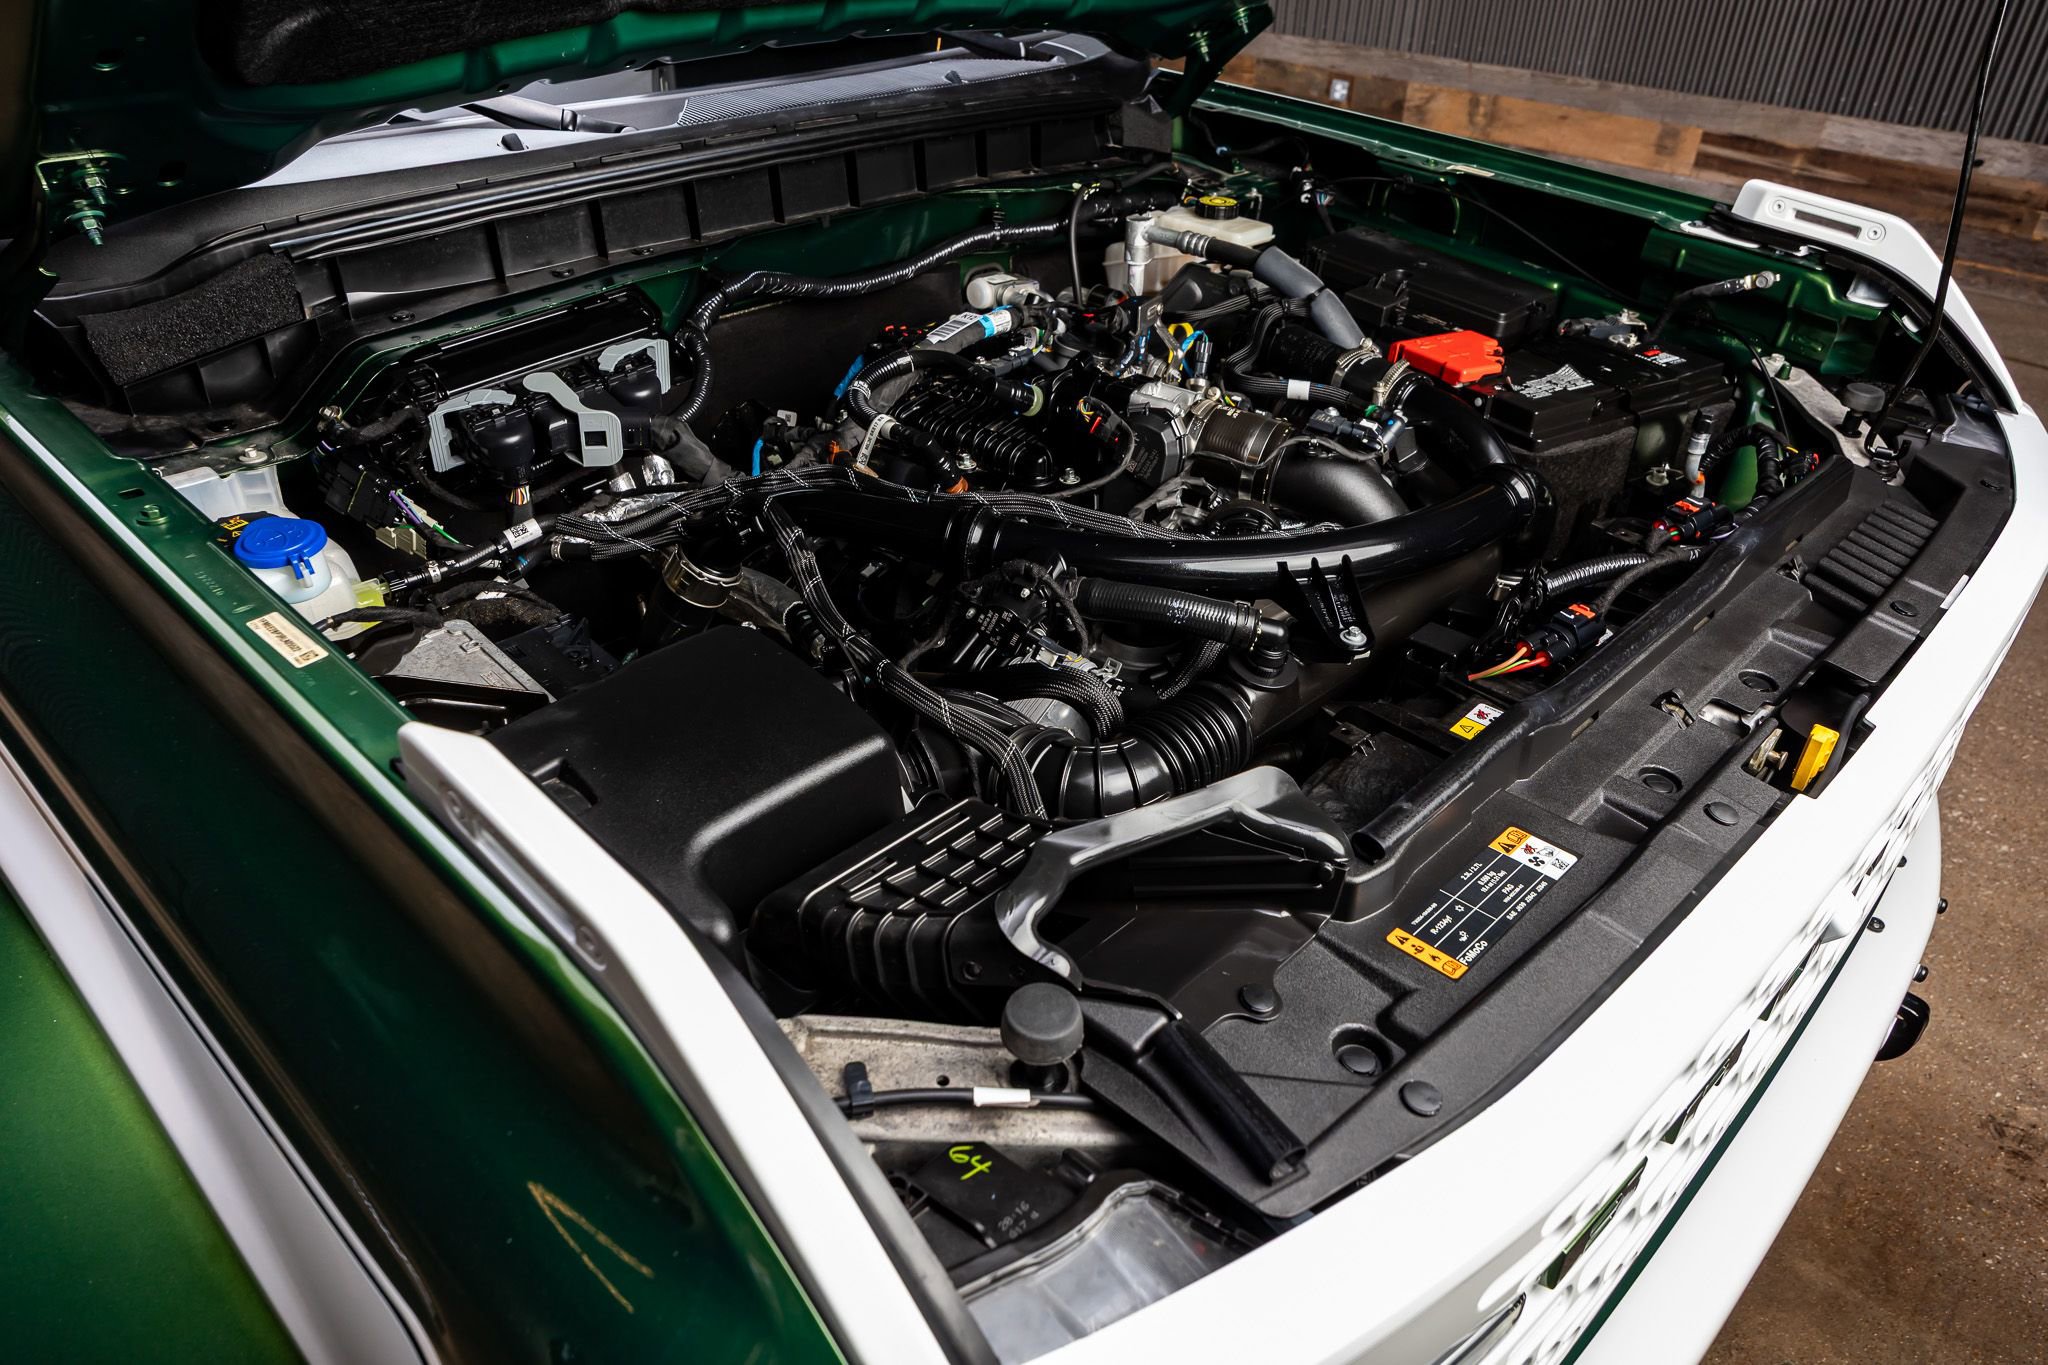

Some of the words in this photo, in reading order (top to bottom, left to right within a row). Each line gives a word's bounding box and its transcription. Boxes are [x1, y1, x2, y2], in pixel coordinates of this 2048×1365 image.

[1430, 915, 1453, 934] R-1234yf
[1459, 940, 1488, 965] FoMoCo
[949, 1145, 992, 1180] 64
